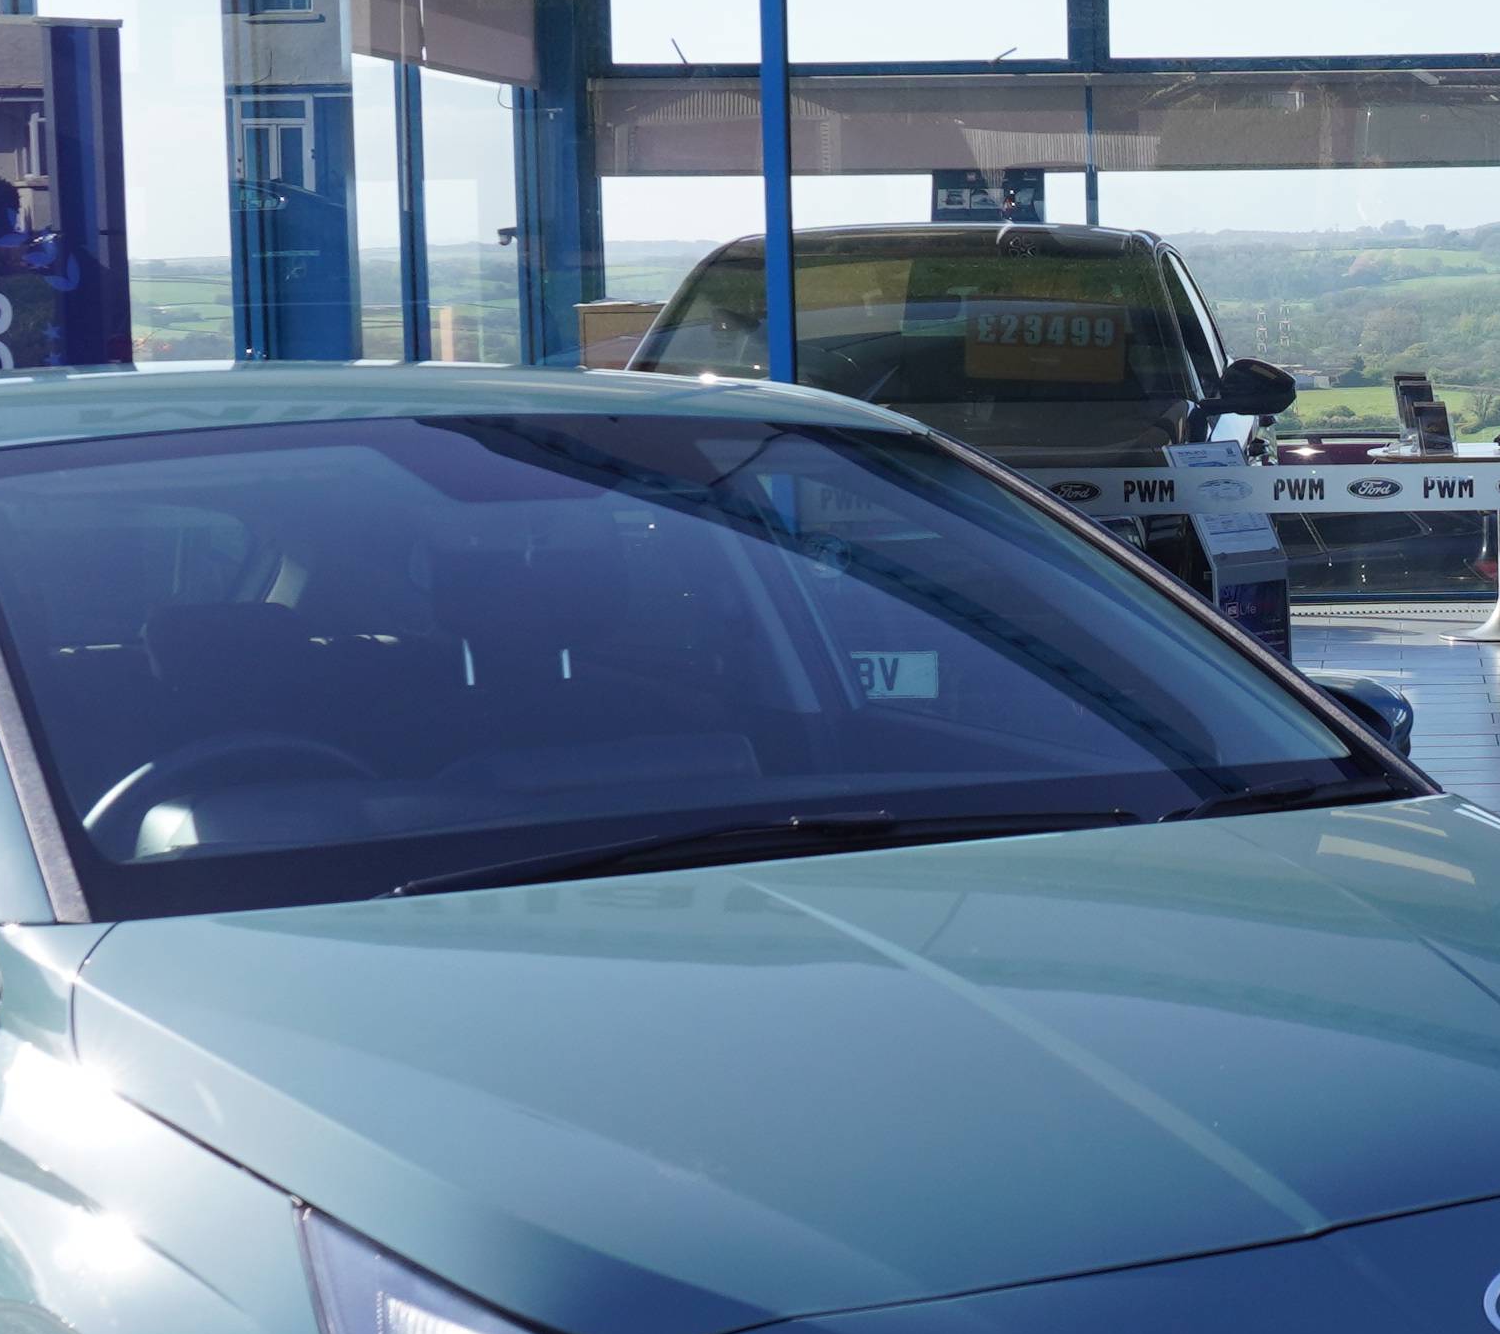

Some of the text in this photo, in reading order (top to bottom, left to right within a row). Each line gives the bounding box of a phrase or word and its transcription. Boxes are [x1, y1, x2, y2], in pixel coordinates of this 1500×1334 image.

[976, 313, 1115, 348] £23499
[1123, 480, 1175, 503] PWM
[1274, 477, 1325, 500] PWM
[1423, 476, 1474, 498] PWM
